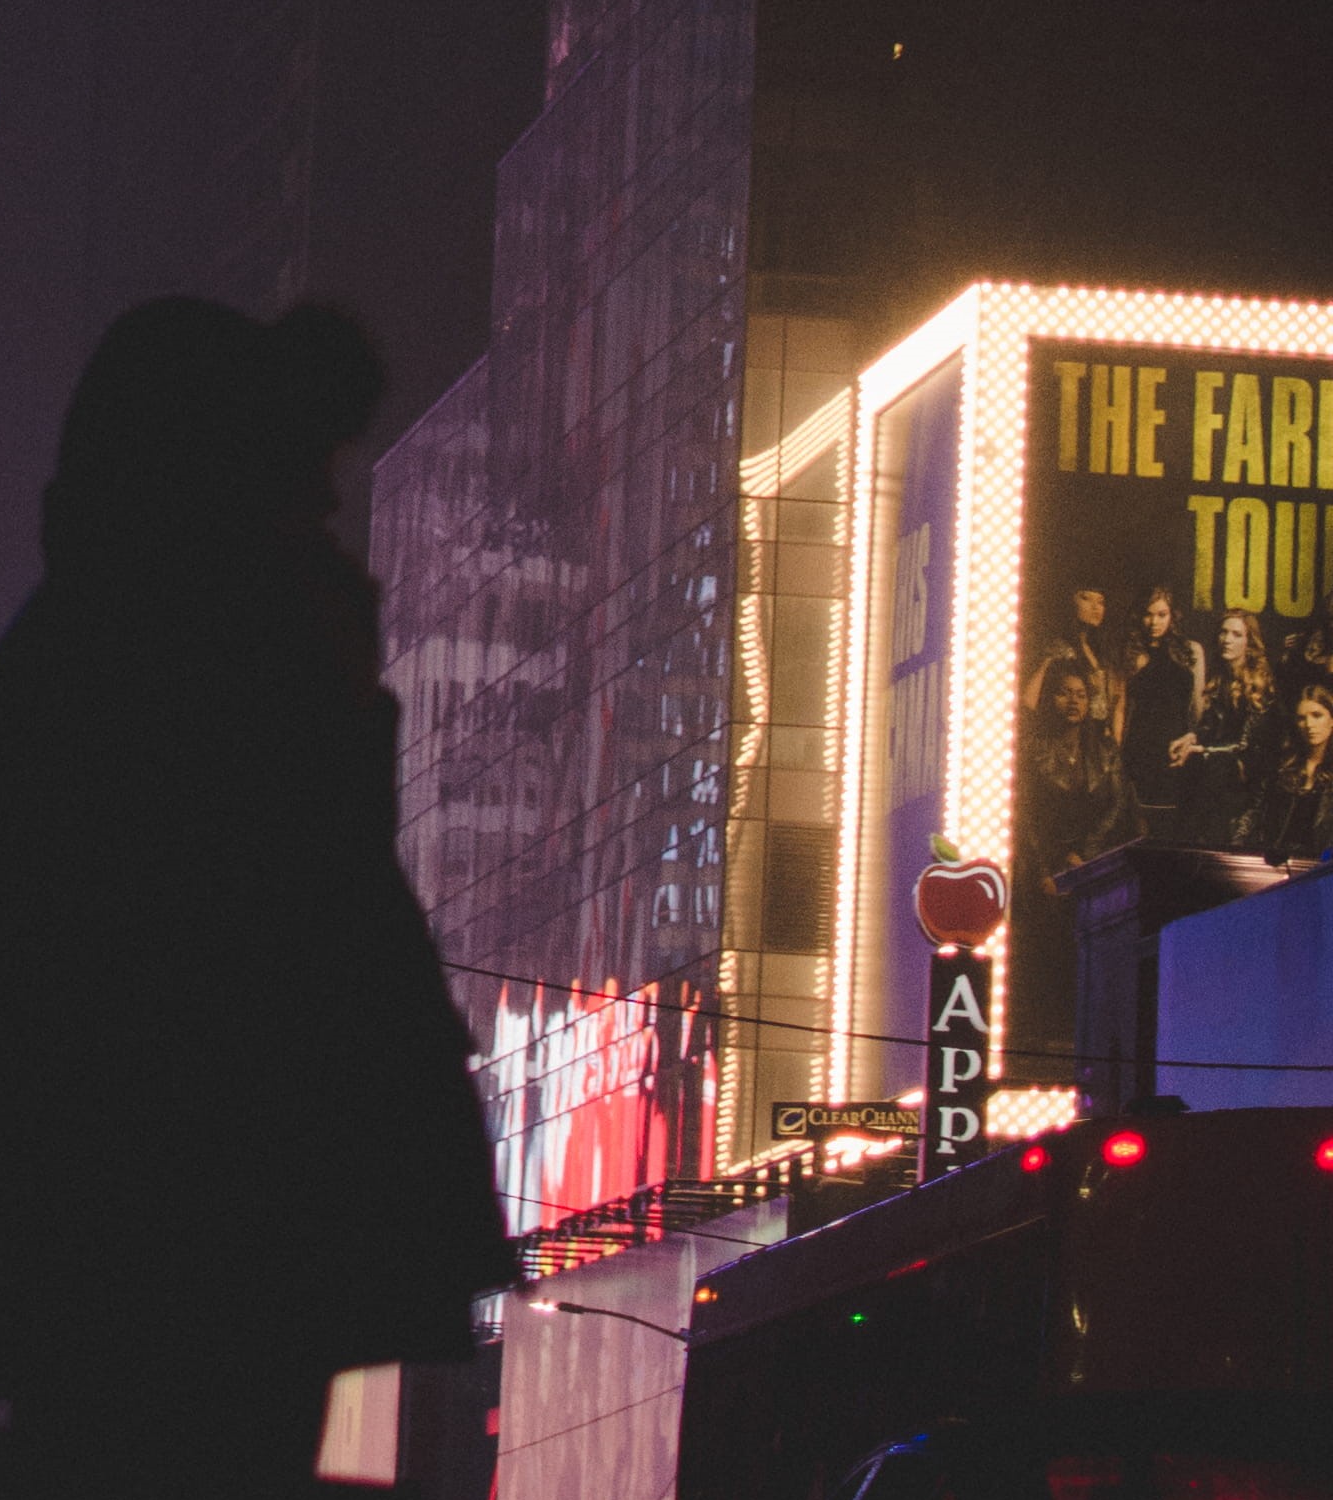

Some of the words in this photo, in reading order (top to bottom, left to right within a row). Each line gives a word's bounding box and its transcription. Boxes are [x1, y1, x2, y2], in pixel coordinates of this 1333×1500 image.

[1053, 361, 1168, 478] THE
[1187, 495, 1333, 619] TOU
[931, 973, 990, 1170] APP
